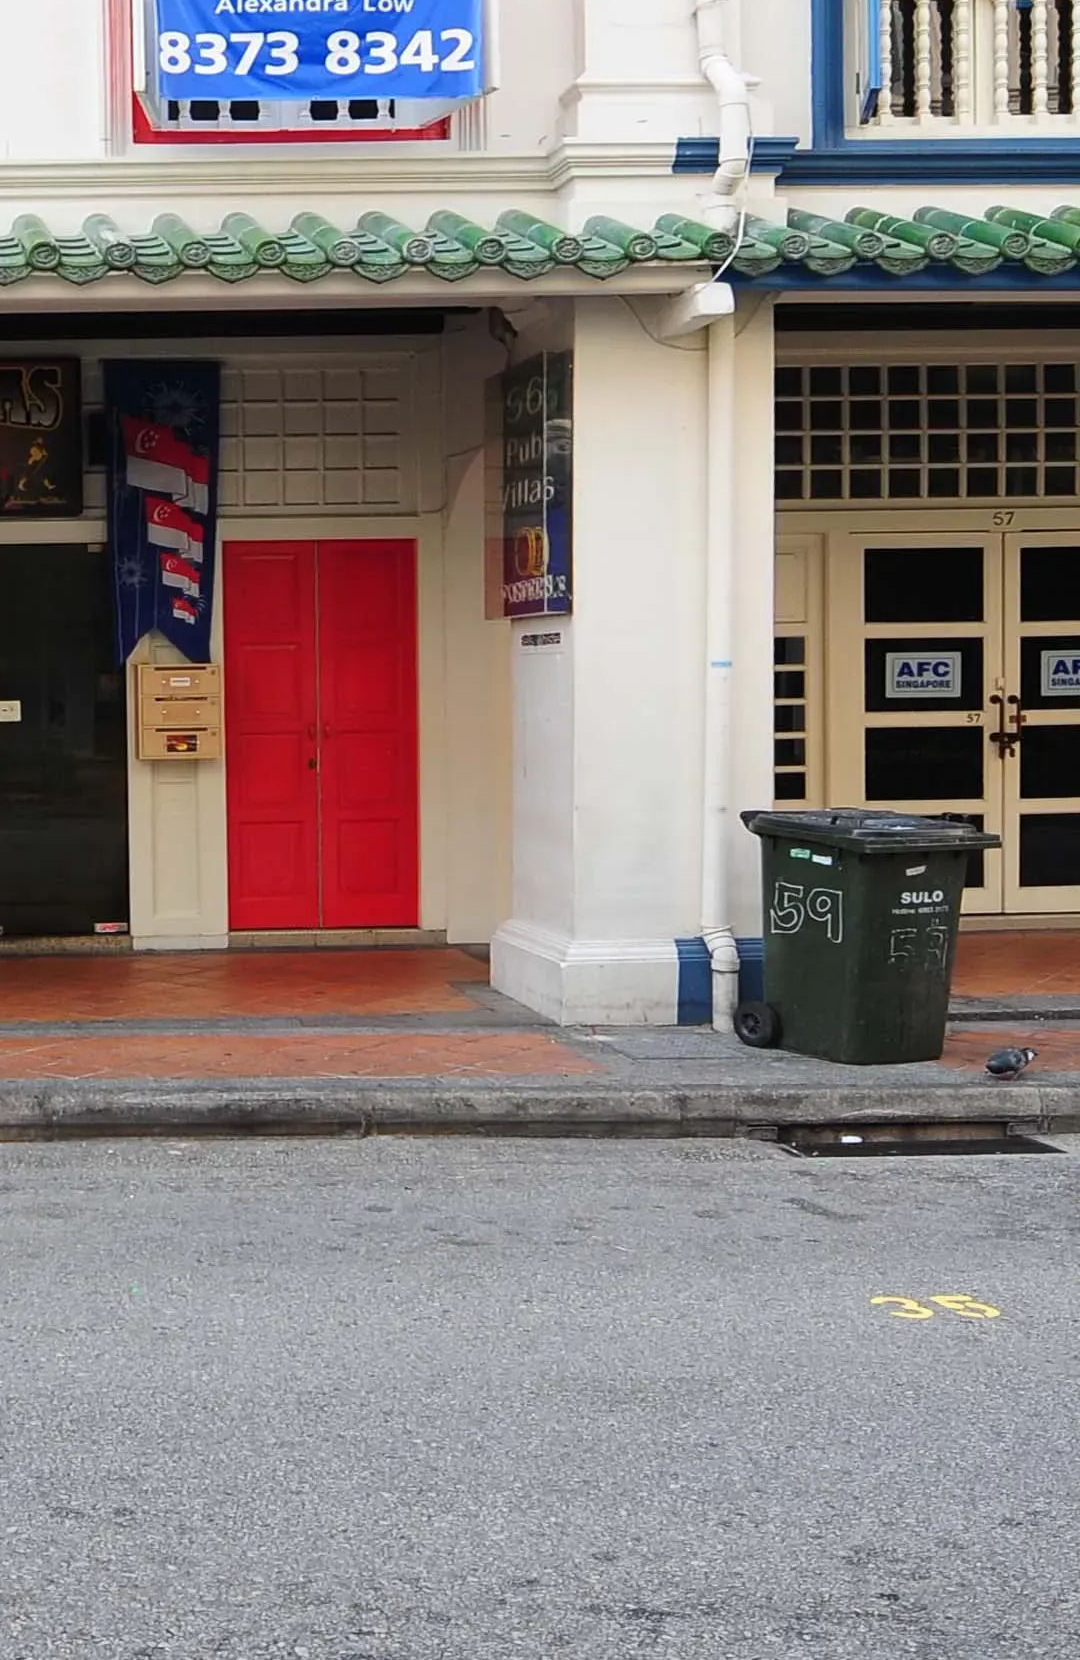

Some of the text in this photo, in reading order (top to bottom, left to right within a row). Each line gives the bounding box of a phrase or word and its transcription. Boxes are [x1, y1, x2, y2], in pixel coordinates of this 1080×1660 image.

[159, 28, 474, 76] 8373 8342
[506, 430, 542, 468] Pub
[992, 511, 1014, 526] 57
[897, 662, 951, 678] AFC
[896, 680, 951, 689] SINGAPORE
[967, 714, 980, 723] 57
[900, 890, 944, 904] SULO
[770, 881, 843, 943] 59
[870, 1295, 1001, 1319] 35
